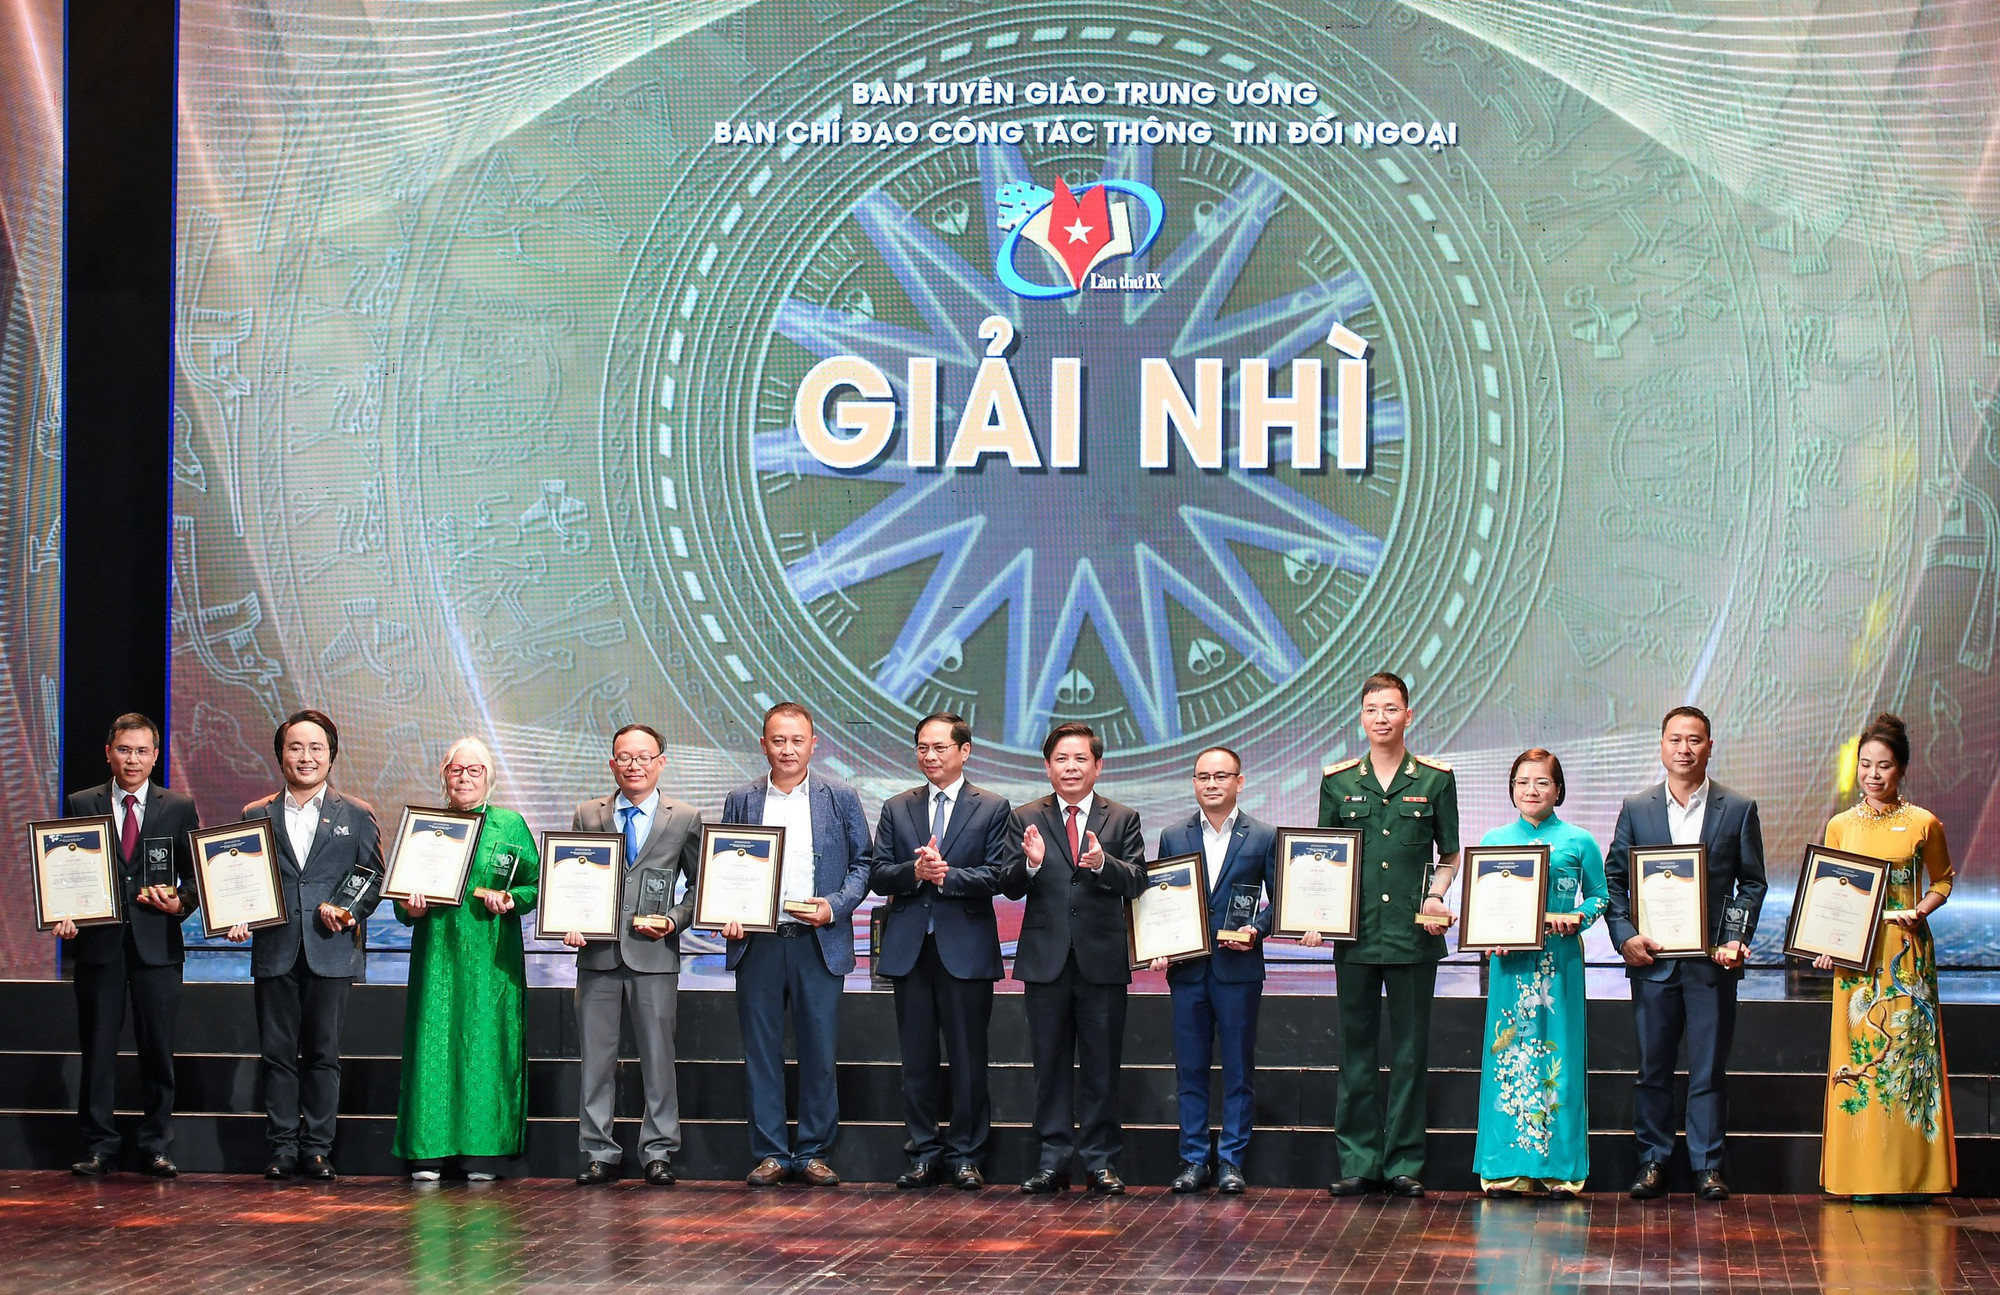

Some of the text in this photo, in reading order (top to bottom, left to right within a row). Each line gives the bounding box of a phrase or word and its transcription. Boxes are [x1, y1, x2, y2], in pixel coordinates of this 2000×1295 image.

[852, 75, 1318, 105] BAN TUYÊN GIÁO TRUNG ƯƠNG
[714, 121, 776, 144] BAN
[850, 121, 919, 150] ĐẠO
[928, 115, 1024, 144] CÔNG
[1032, 115, 1094, 144] TÁC
[1103, 115, 1212, 144] THÔNG
[1230, 121, 1277, 144] TIN
[1287, 113, 1343, 144] ĐỐI
[1354, 121, 1456, 151] NGOẠI
[1090, 272, 1163, 289] Lần thứ IX
[795, 314, 1369, 470] GIẢI NHÌ
